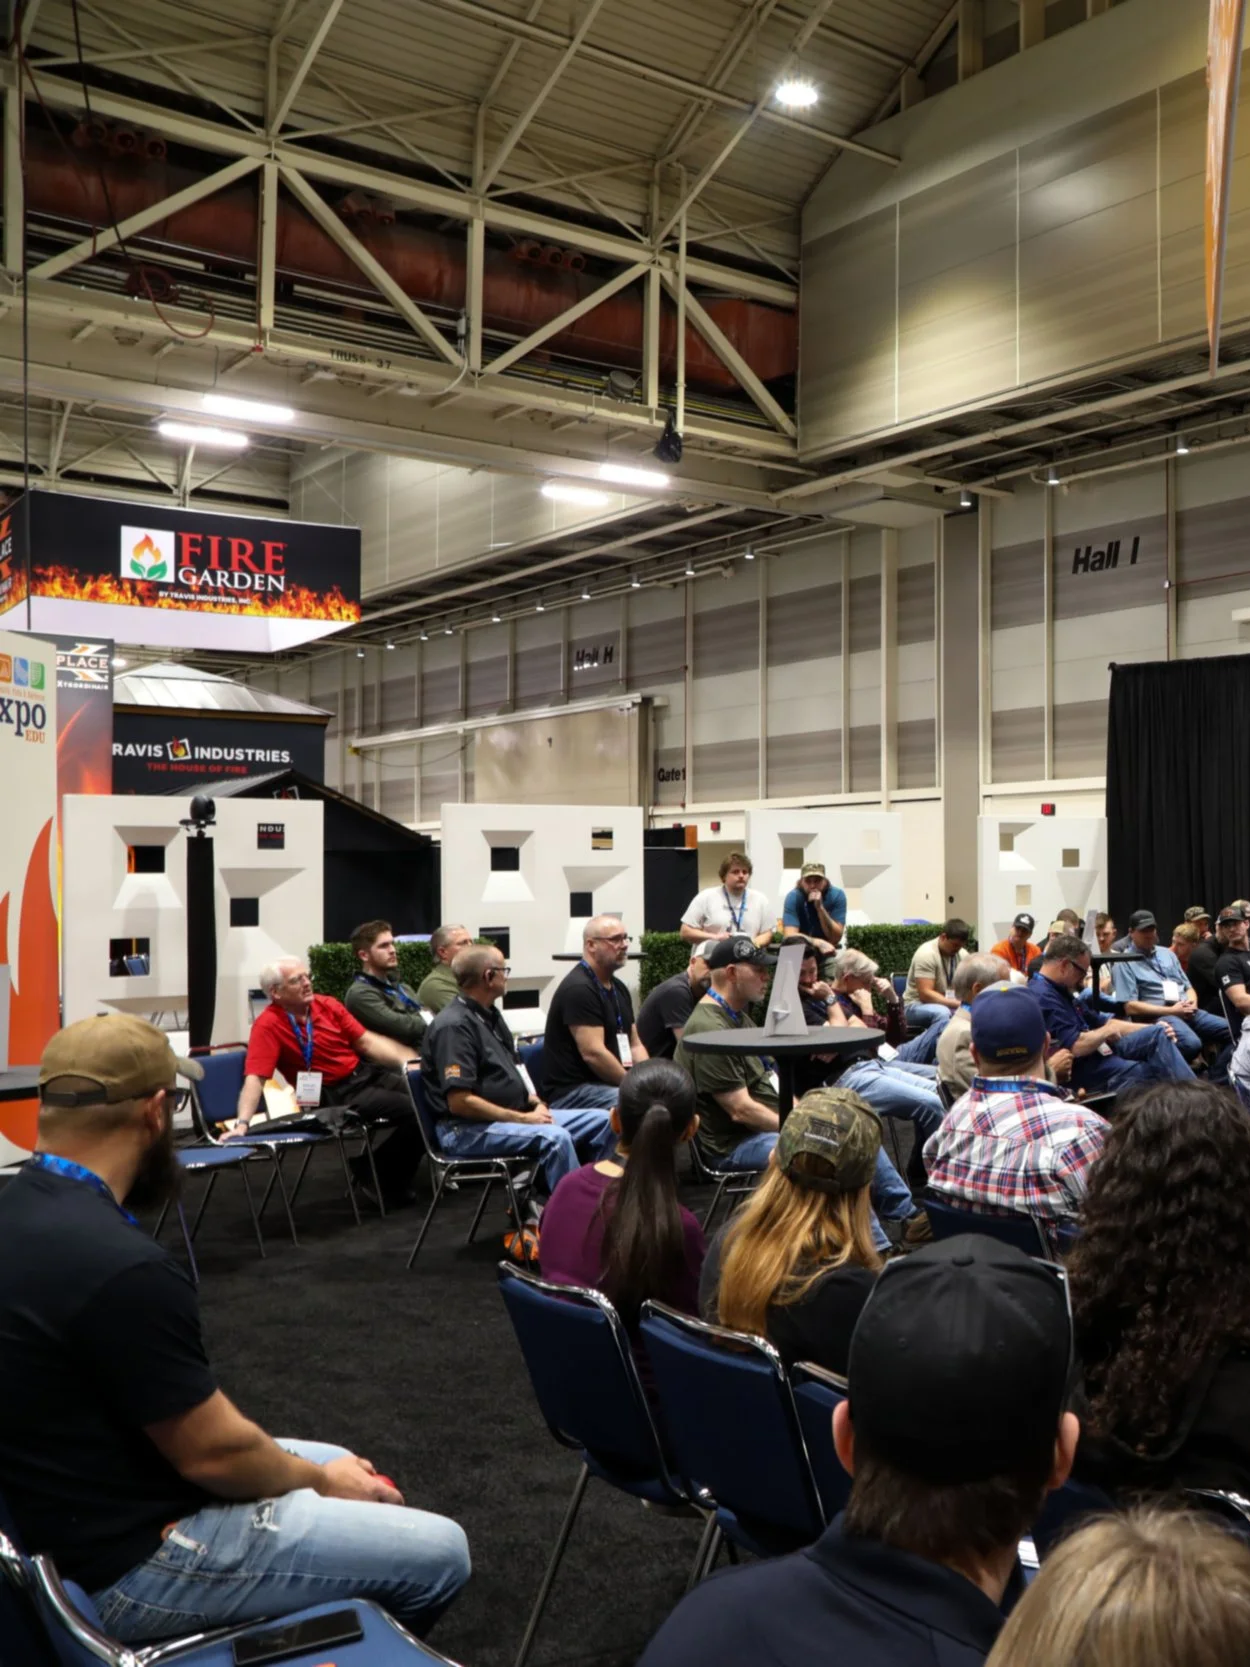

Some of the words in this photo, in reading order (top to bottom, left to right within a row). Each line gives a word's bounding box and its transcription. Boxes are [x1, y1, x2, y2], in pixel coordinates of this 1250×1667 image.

[177, 532, 286, 575] FIRE
[1072, 539, 1120, 574] Hall
[1130, 536, 1140, 565] I
[178, 567, 285, 592] GARDEN
[170, 592, 195, 600] TRAVIS
[56, 656, 108, 668] PLACE
[603, 646, 614, 664] H
[0, 697, 46, 737] xpo
[25, 729, 45, 743] EDU
[112, 743, 163, 757] RAVIS
[195, 746, 291, 763] INDUSTRIES
[147, 762, 167, 772] THE
[170, 763, 206, 773] HOUSE
[208, 764, 222, 773] OF
[225, 764, 248, 774] FIRE
[657, 768, 681, 782] Gate
[259, 825, 284, 833] NDU
